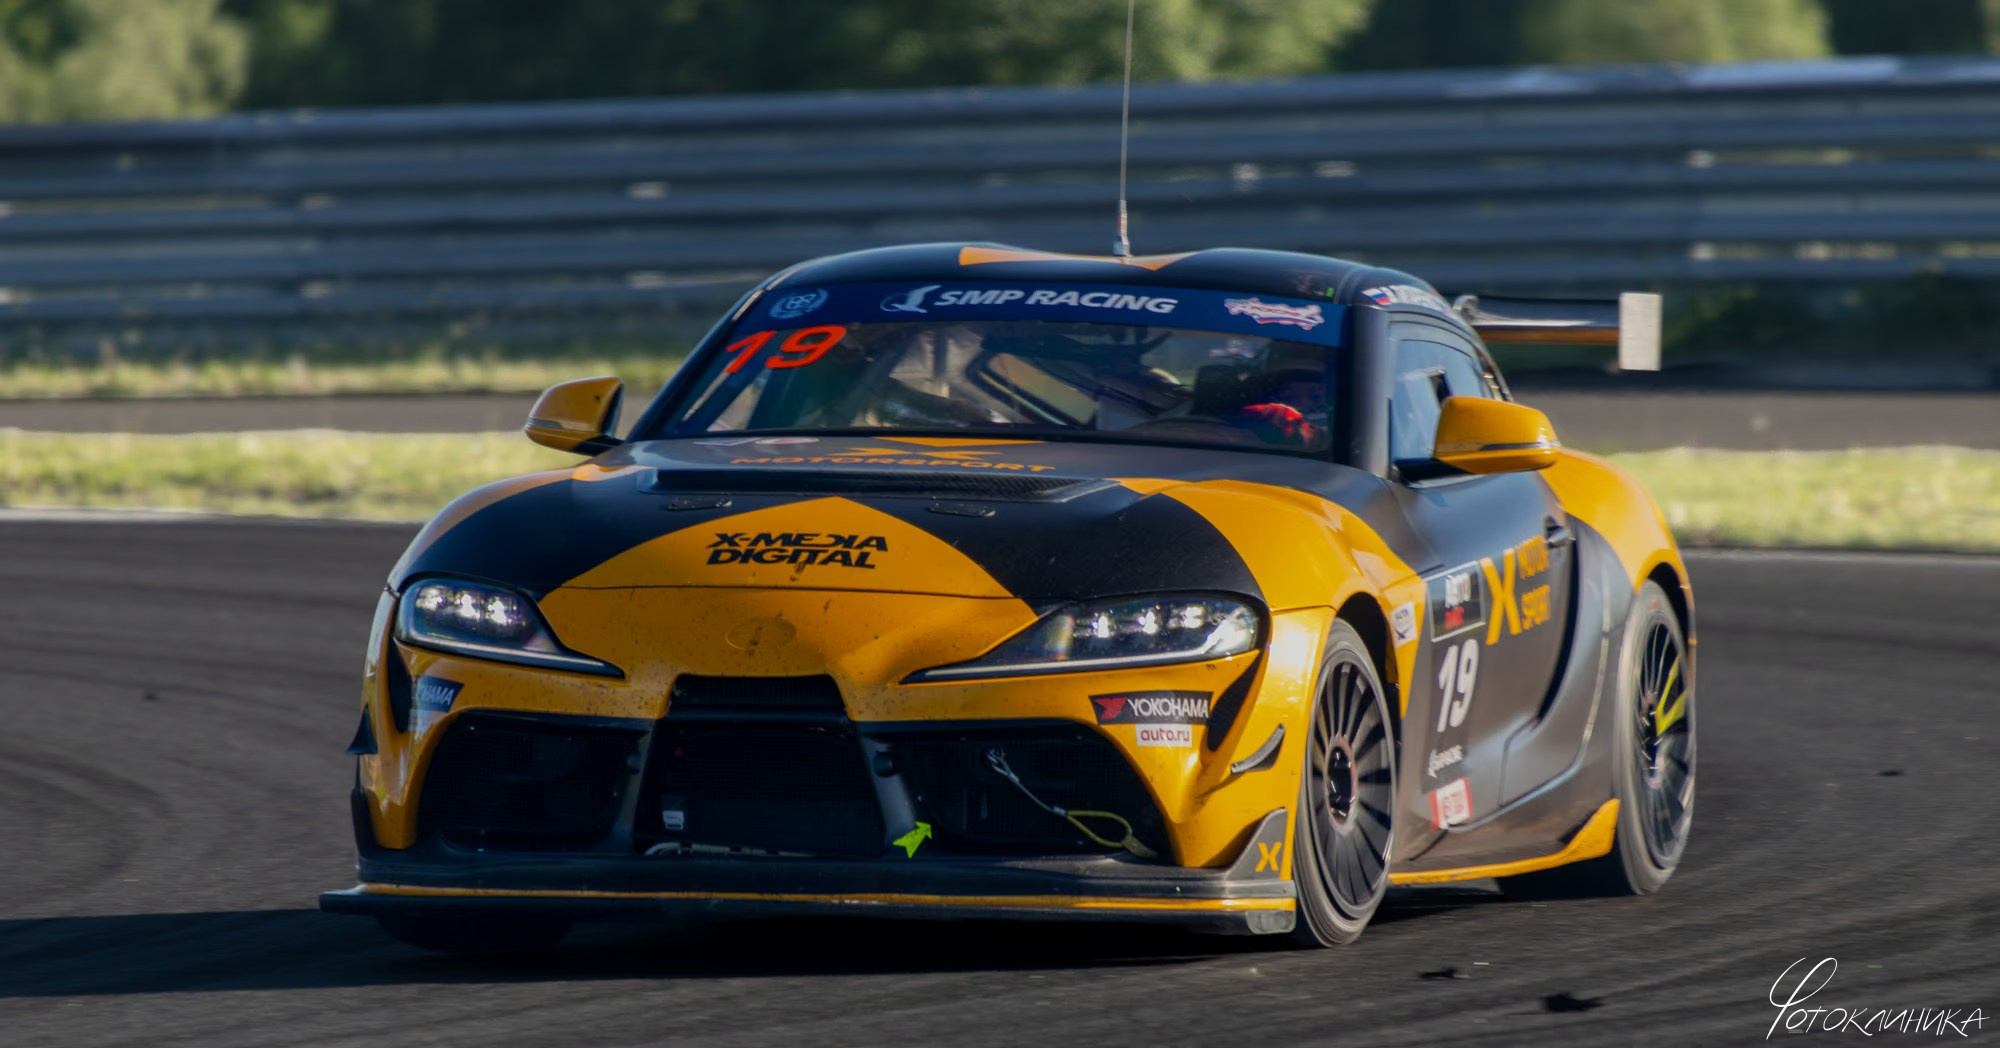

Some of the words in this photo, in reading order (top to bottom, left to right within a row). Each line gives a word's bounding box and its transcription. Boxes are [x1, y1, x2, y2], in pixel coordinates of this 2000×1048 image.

[934, 289, 1025, 306] SMP
[1025, 289, 1178, 313] RACING
[725, 325, 847, 374] 19
[730, 456, 1056, 472] MOTORSPORT
[706, 548, 876, 569] DIGITAL
[1479, 548, 1522, 646] X
[1438, 638, 1479, 732] 19
[1127, 697, 1209, 719] YOKOHAMA
[1140, 728, 1190, 742] auto.ru
[1255, 842, 1281, 873] X
